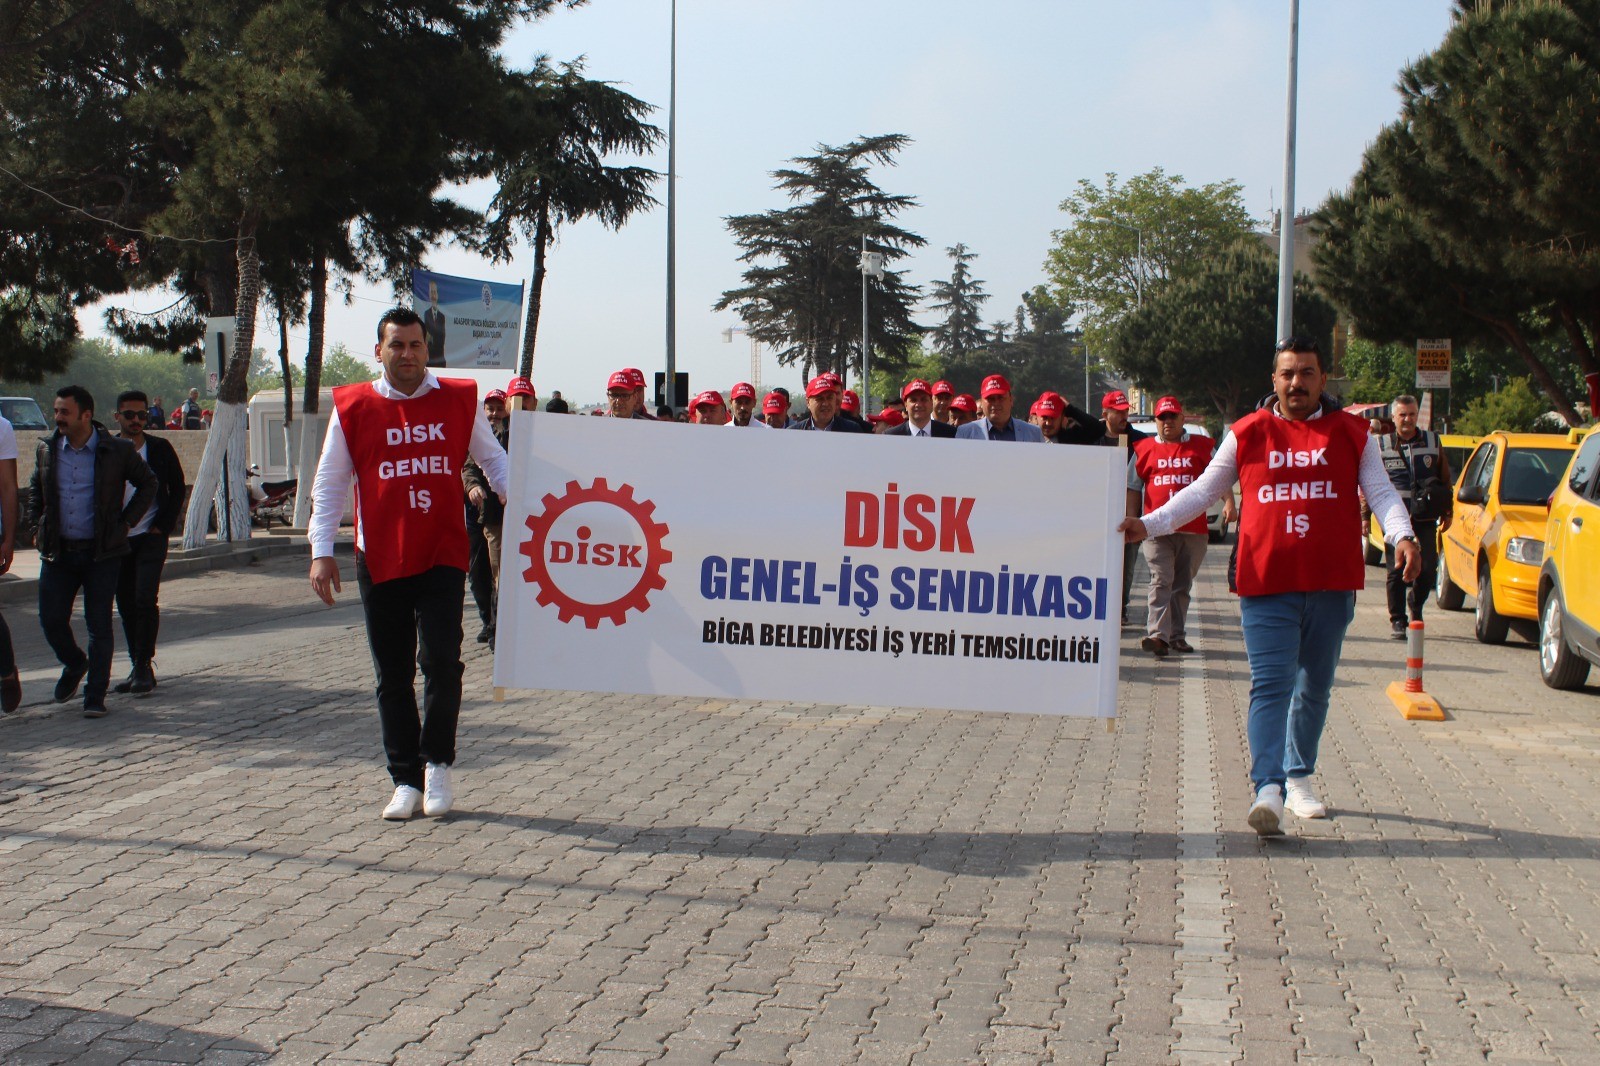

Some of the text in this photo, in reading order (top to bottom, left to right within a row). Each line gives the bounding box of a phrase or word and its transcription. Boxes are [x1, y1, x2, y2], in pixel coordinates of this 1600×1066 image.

[386, 421, 446, 446] DİSK
[378, 455, 452, 480] GENEL
[1157, 456, 1193, 469] DİSK
[1268, 447, 1329, 469] DİSK
[409, 485, 432, 513] İŞ
[1257, 480, 1338, 504] GENEL
[843, 482, 976, 553] DİSK
[1286, 510, 1310, 538] İŞ
[549, 525, 642, 568] DİSK
[700, 555, 1108, 620] GENEL-İŞ SENDİKASI
[702, 617, 1100, 663] BİGA BELEDİYESİ İŞ YERİ TEMSİLCİLİĞİ
